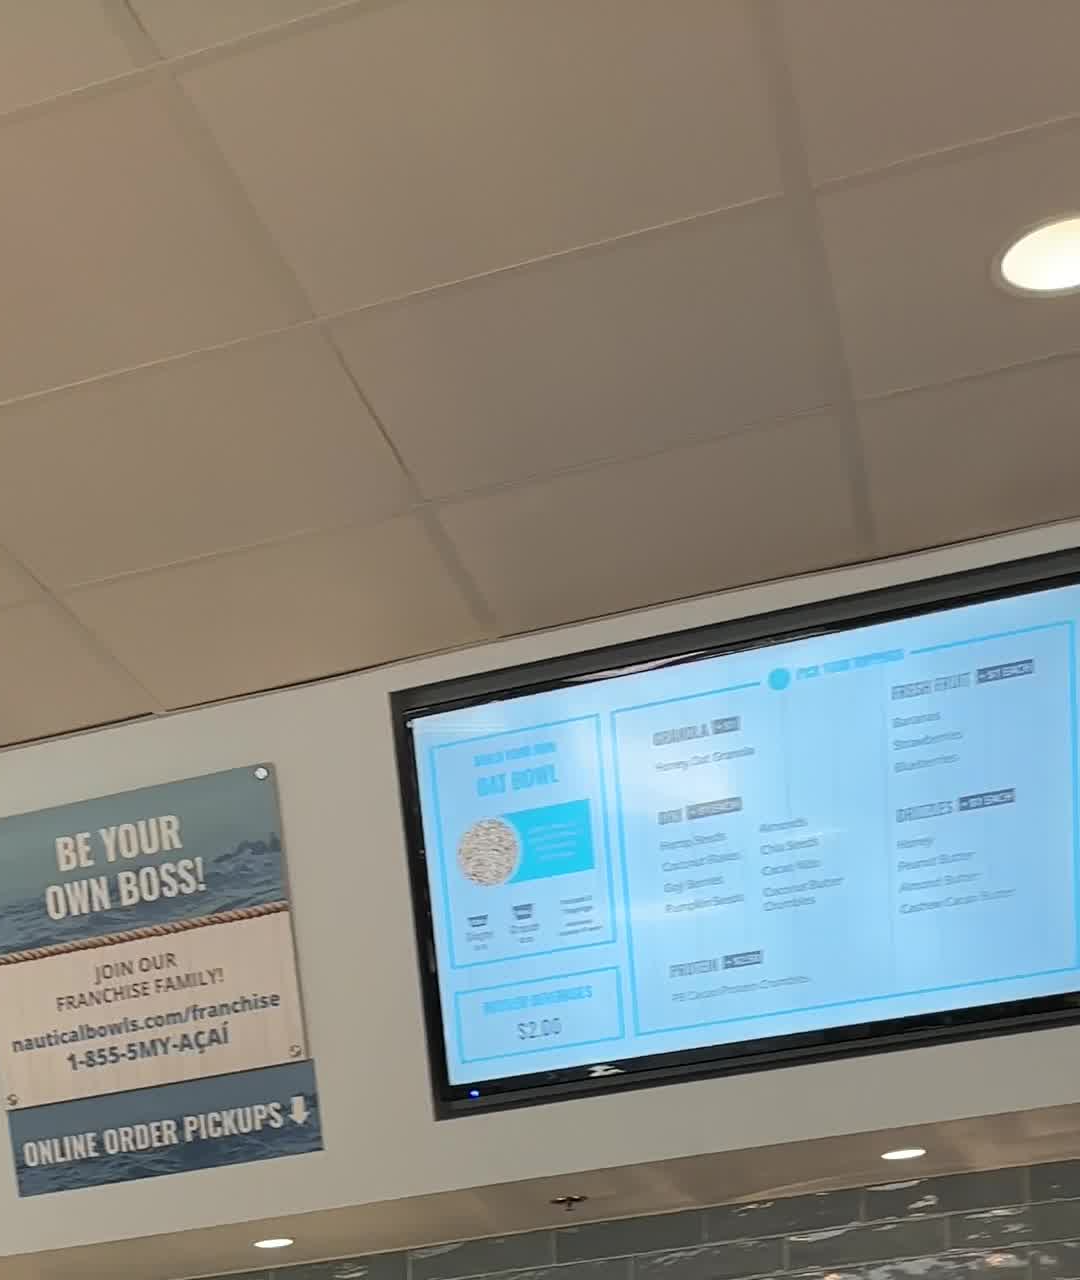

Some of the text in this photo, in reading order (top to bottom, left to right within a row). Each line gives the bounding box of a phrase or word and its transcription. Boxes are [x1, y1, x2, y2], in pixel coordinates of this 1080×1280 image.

[55, 814, 183, 873] BE YOUR
[45, 856, 207, 921] OWN BOSS!
[56, 967, 224, 1013] FRANCHISE FAMILY!
[95, 952, 178, 986] JOIN OUR
[11, 990, 281, 1055] nauticalbowls.com/franchise
[23, 1100, 284, 1168] ONLINE ORDER PICKUPS
